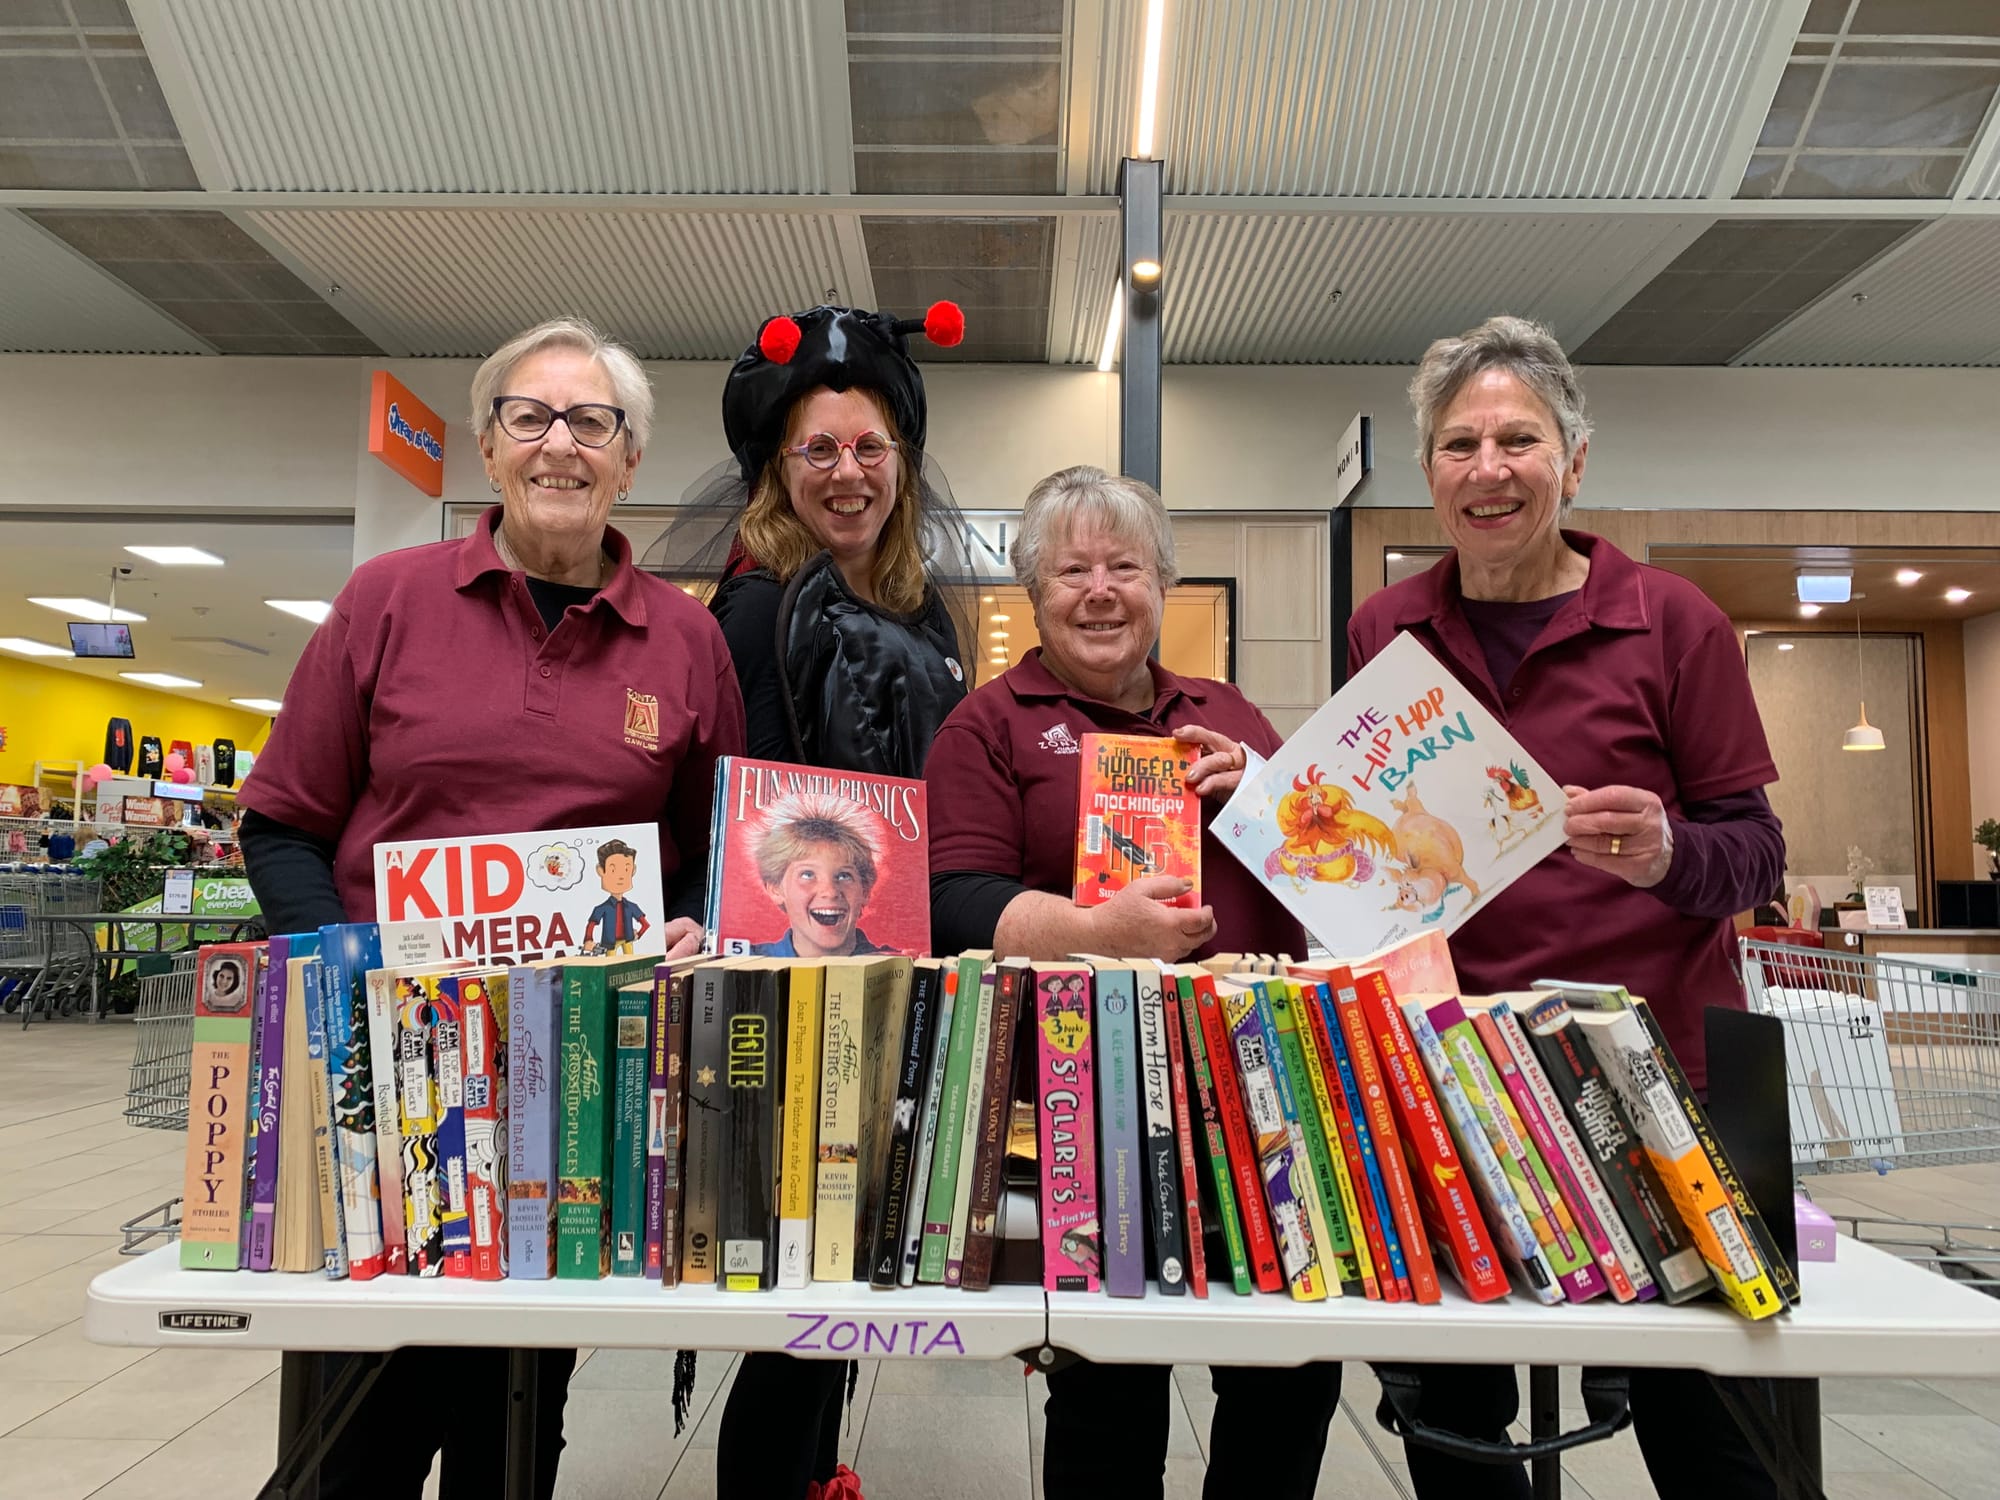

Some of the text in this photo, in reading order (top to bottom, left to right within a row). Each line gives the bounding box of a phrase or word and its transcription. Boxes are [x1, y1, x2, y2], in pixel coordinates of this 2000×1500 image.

[1338, 448, 1352, 479] NONI
[626, 687, 658, 703] ZONTA
[1038, 739, 1080, 749] ZONT
[1337, 706, 1388, 749] THE
[1352, 686, 1445, 791] HIP HOP
[1097, 755, 1174, 779] HUNGER
[1115, 747, 1131, 756] THE
[1379, 711, 1475, 792] BARN
[736, 766, 920, 841] FUN WITH PHYSICS
[1094, 793, 1184, 815] MOCKINGJAY
[1112, 774, 1183, 796] GAMES
[386, 843, 525, 922] KID
[387, 851, 403, 869] A
[206, 899, 248, 912] everyday
[443, 912, 574, 958] MERA
[732, 942, 743, 954] 5
[330, 965, 346, 1043] Chicken Soup for the Soul
[372, 978, 389, 1016] Saunders
[569, 979, 581, 1033] AT THE
[657, 979, 667, 1020] THE SECRET
[703, 982, 713, 1024] SUZY ZAIL
[975, 989, 991, 1052] WHAT ABOUT
[402, 1031, 413, 1059] GATES
[412, 1030, 424, 1056] TOM
[438, 1022, 449, 1050] GATES
[447, 1022, 458, 1047] TOM
[468, 1008, 479, 1041] Brilliant
[903, 979, 929, 1087] THE Quicksand Pony
[1051, 1019, 1083, 1034] 3 books
[1066, 1034, 1075, 1048] 1
[1140, 985, 1171, 1111] Storm Horse
[212, 1051, 230, 1060] THE
[513, 977, 524, 1172] KING OF THE MARCH
[525, 1032, 547, 1099] Arthur
[578, 1034, 600, 1101] Arthur
[728, 1015, 767, 1088] GONE
[824, 991, 841, 1128] THE SEEING STONE
[842, 1020, 859, 1085] Arthur
[1238, 1037, 1256, 1071] GATES
[1249, 1036, 1267, 1067] TOM
[1371, 974, 1451, 1159] THE BOOK OF HOT JOKES
[1380, 1032, 1417, 1110] FOR KOOL KIDS
[406, 1067, 417, 1112] BIT LUCKY
[449, 1054, 460, 1103] TOP of the
[466, 1078, 477, 1107] GATES
[475, 1078, 487, 1105] TOM
[621, 1058, 636, 1122] BUSHRANGING
[924, 1036, 948, 1145] BOSS OF THE POOL
[1181, 997, 1225, 1157] Dinosaurs aren't dead
[1354, 1038, 1392, 1137] GRAVES GLORY
[377, 1083, 393, 1136] Beswitched
[630, 1058, 645, 1168] HISTORY OF AUSTRALIAN
[788, 1000, 807, 1211] Joan Phipson The Watcher in the Garden
[1256, 1087, 1272, 1123] FANTASTIC
[1500, 1013, 1533, 1066] MIRANDA'S
[1527, 1066, 1548, 1094] DAILY
[1542, 1094, 1563, 1123] DOSE
[1557, 1123, 1572, 1141] OF
[1565, 1139, 1586, 1169] SUCH
[1581, 1169, 1600, 1194] FUN!
[1577, 1076, 1628, 1150] HUNGER
[200, 1064, 231, 1204] POPPY
[940, 1084, 959, 1178] TEARS OF THE GIRAFFE
[1046, 1089, 1083, 1204] CLARE'S
[1286, 1040, 1339, 1225] SHAUN THE SHEEP THE THE
[1488, 1097, 1523, 1158] TREEHOUSE
[1573, 1096, 1617, 1162] GAMES
[1156, 1149, 1170, 1181] Nick
[192, 1209, 230, 1218] STORIES
[883, 1142, 906, 1240] ALISON LESTER
[1115, 1148, 1131, 1256] Jacqueline Harvey
[1239, 1165, 1266, 1243] LEWIS CARROLL
[1731, 1188, 1755, 1220] BOY
[1047, 1210, 1096, 1228] The First Year
[1447, 1186, 1480, 1253] ANDY JONES
[1596, 1197, 1622, 1237] MIRANDA
[730, 1257, 749, 1268] GRA
[170, 1315, 239, 1328] LIFETIME
[785, 1314, 965, 1355] ZONTA
